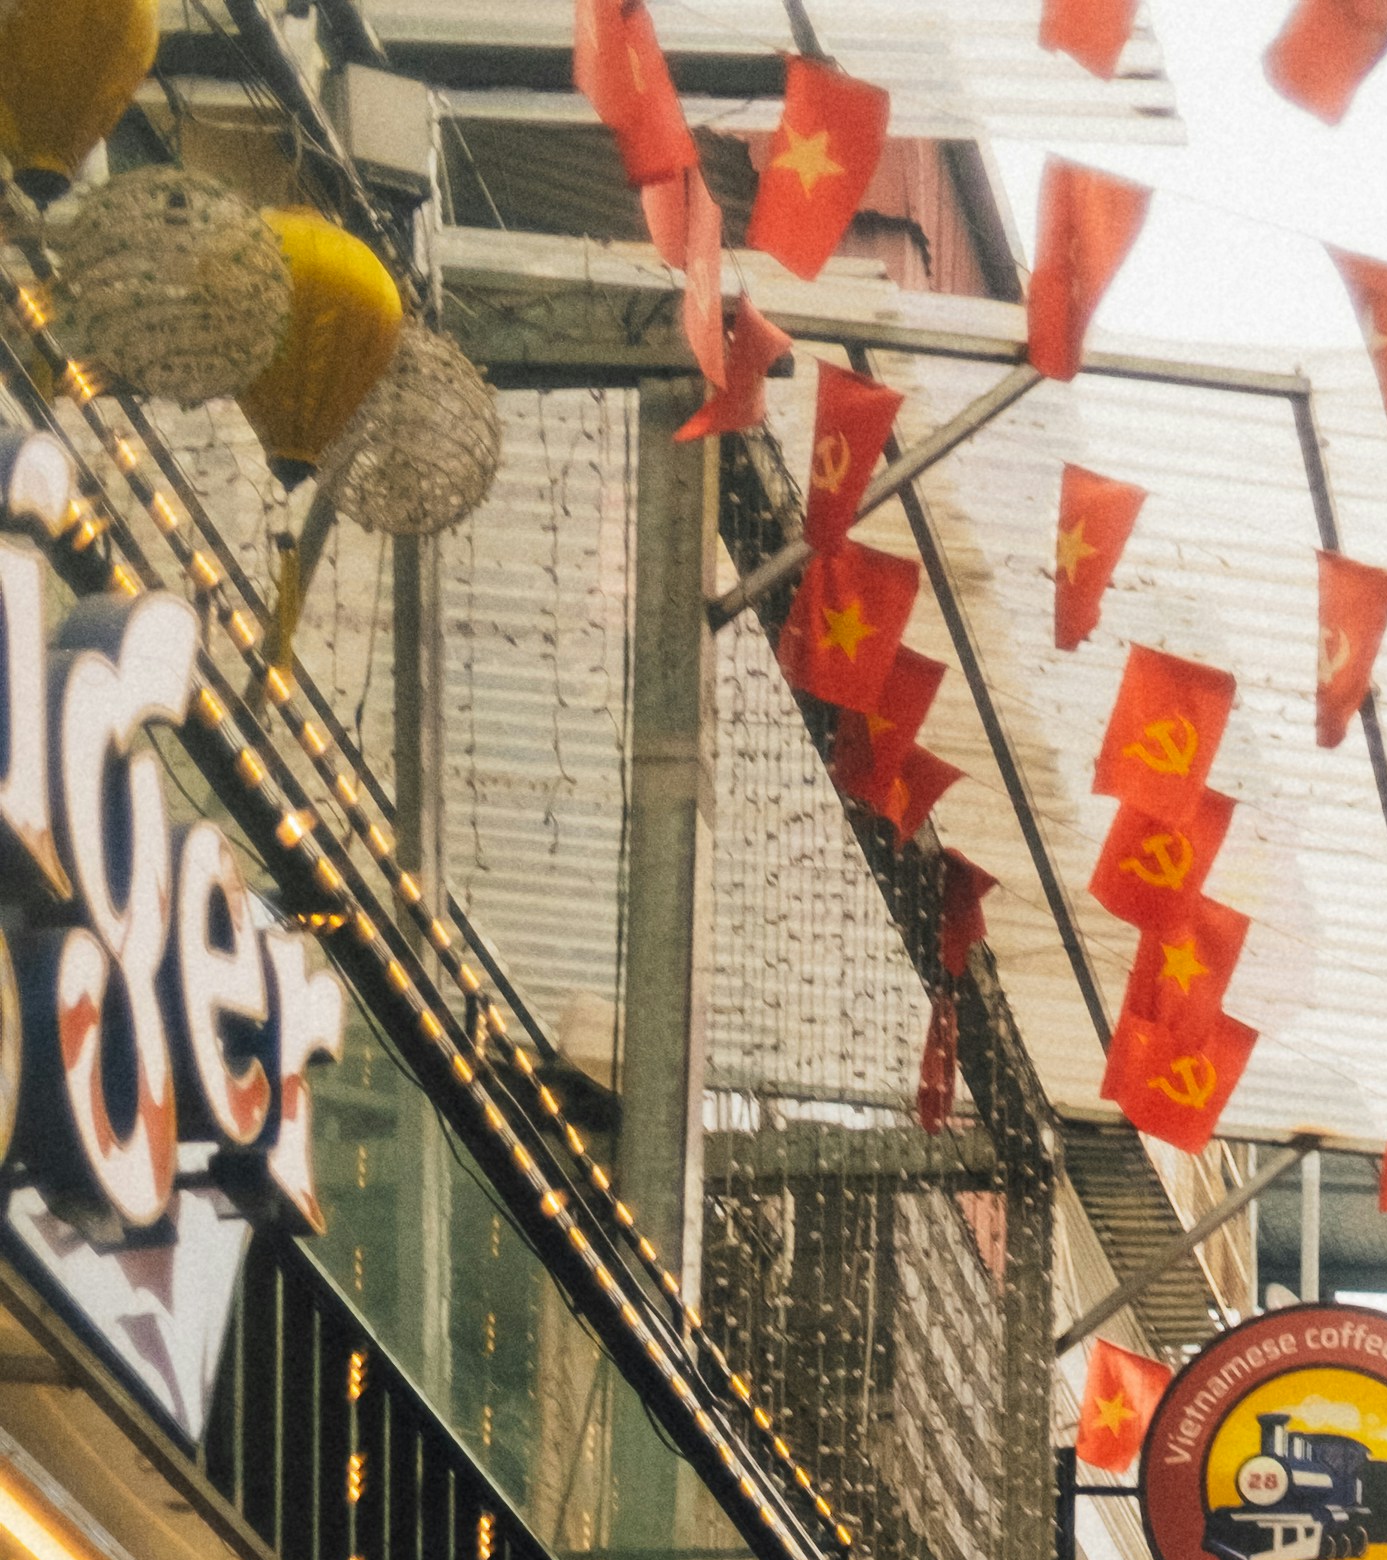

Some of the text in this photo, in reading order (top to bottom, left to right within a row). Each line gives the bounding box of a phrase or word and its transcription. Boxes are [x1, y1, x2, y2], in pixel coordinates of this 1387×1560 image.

[0, 430, 345, 1236] iger
[1164, 1331, 1298, 1467] Vietnamese
[1247, 1470, 1279, 1492] 28
